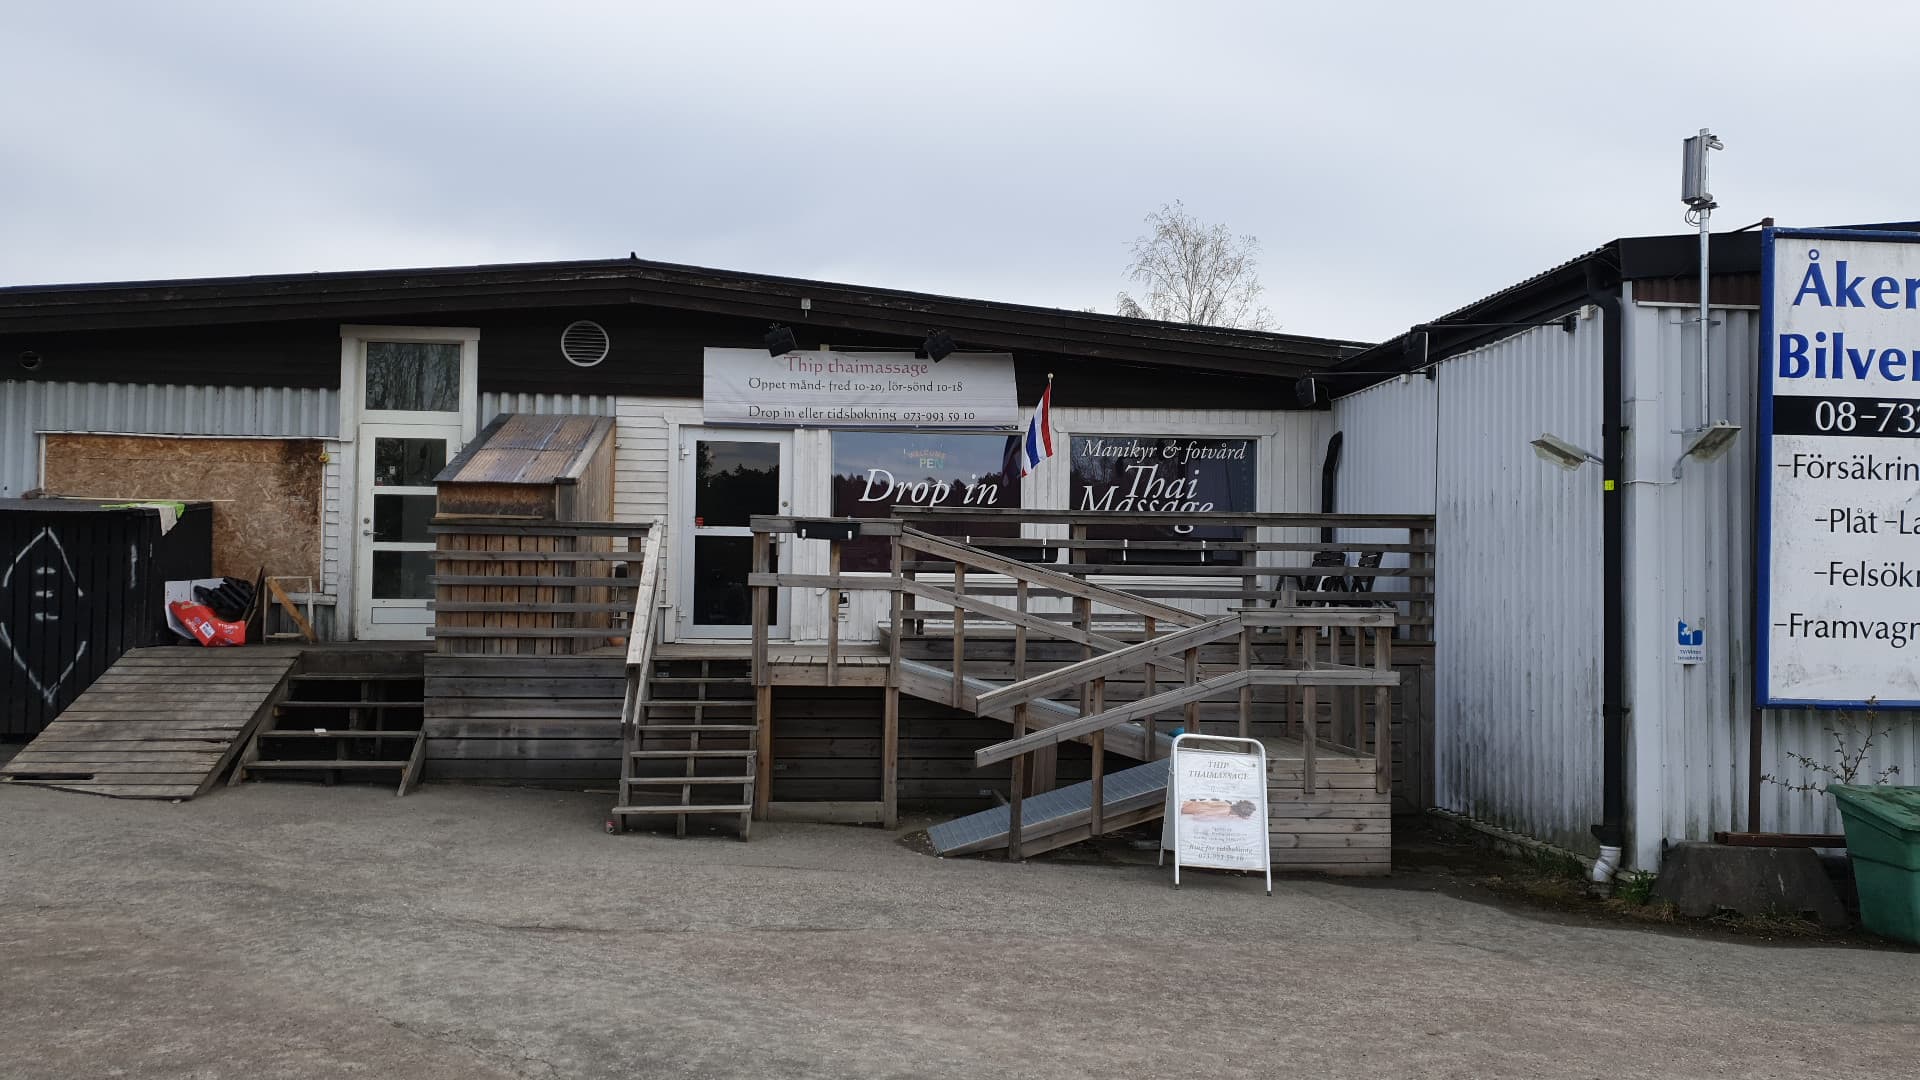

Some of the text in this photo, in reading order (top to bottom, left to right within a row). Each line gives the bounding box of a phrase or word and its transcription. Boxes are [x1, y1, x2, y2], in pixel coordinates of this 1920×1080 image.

[1792, 249, 1920, 309] Åker
[783, 356, 929, 377] Thip thaimassage
[748, 377, 787, 392] Öppet
[828, 378, 851, 393] fred
[888, 379, 933, 392] lör-sönd
[936, 381, 964, 392] 10-18
[748, 405, 976, 422] Drop in eller tidsbokning 073-993 59 10
[1081, 439, 1248, 465] Manikyr & fotvård
[858, 468, 998, 507] Drop in
[1125, 464, 1200, 499] Thai
[1813, 561, 1920, 588] -Felsök
